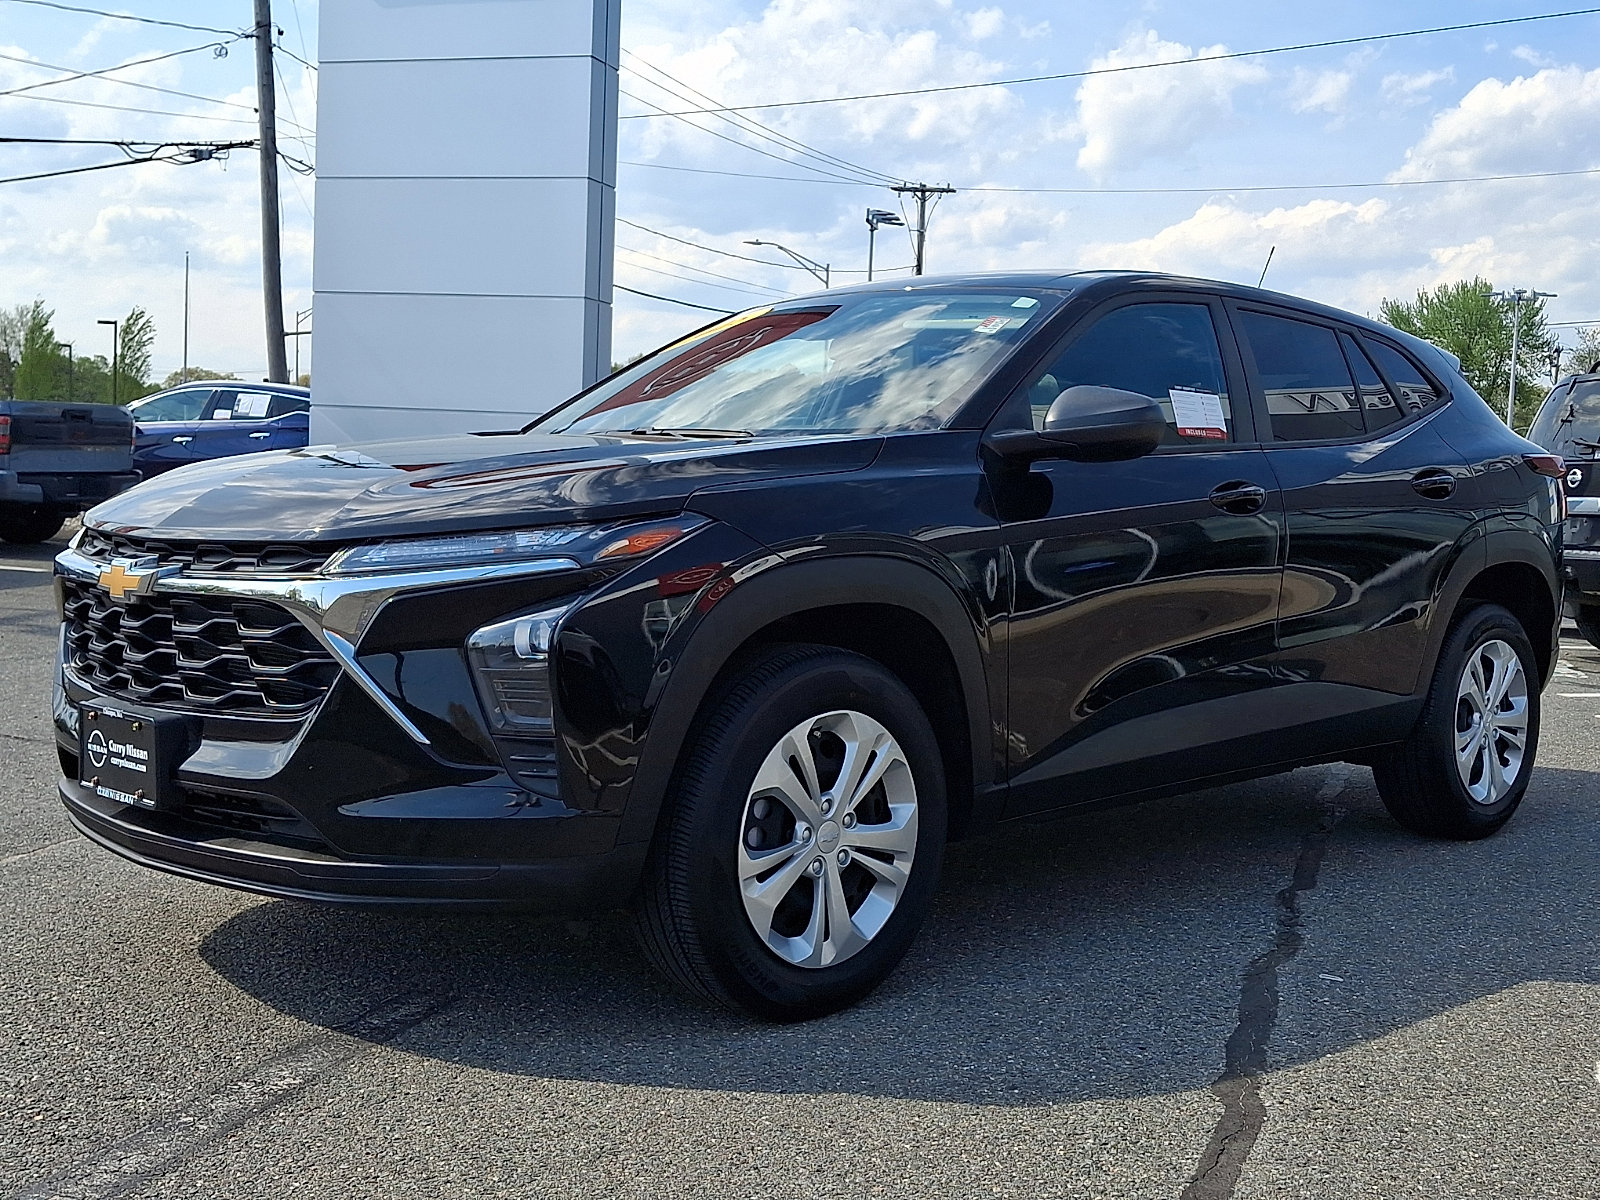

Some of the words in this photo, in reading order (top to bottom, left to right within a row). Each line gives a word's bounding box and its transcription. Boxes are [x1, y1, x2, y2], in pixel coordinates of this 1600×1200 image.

[87, 742, 108, 755] NISSAN
[108, 739, 126, 757] Curry
[126, 743, 149, 761] Nissan
